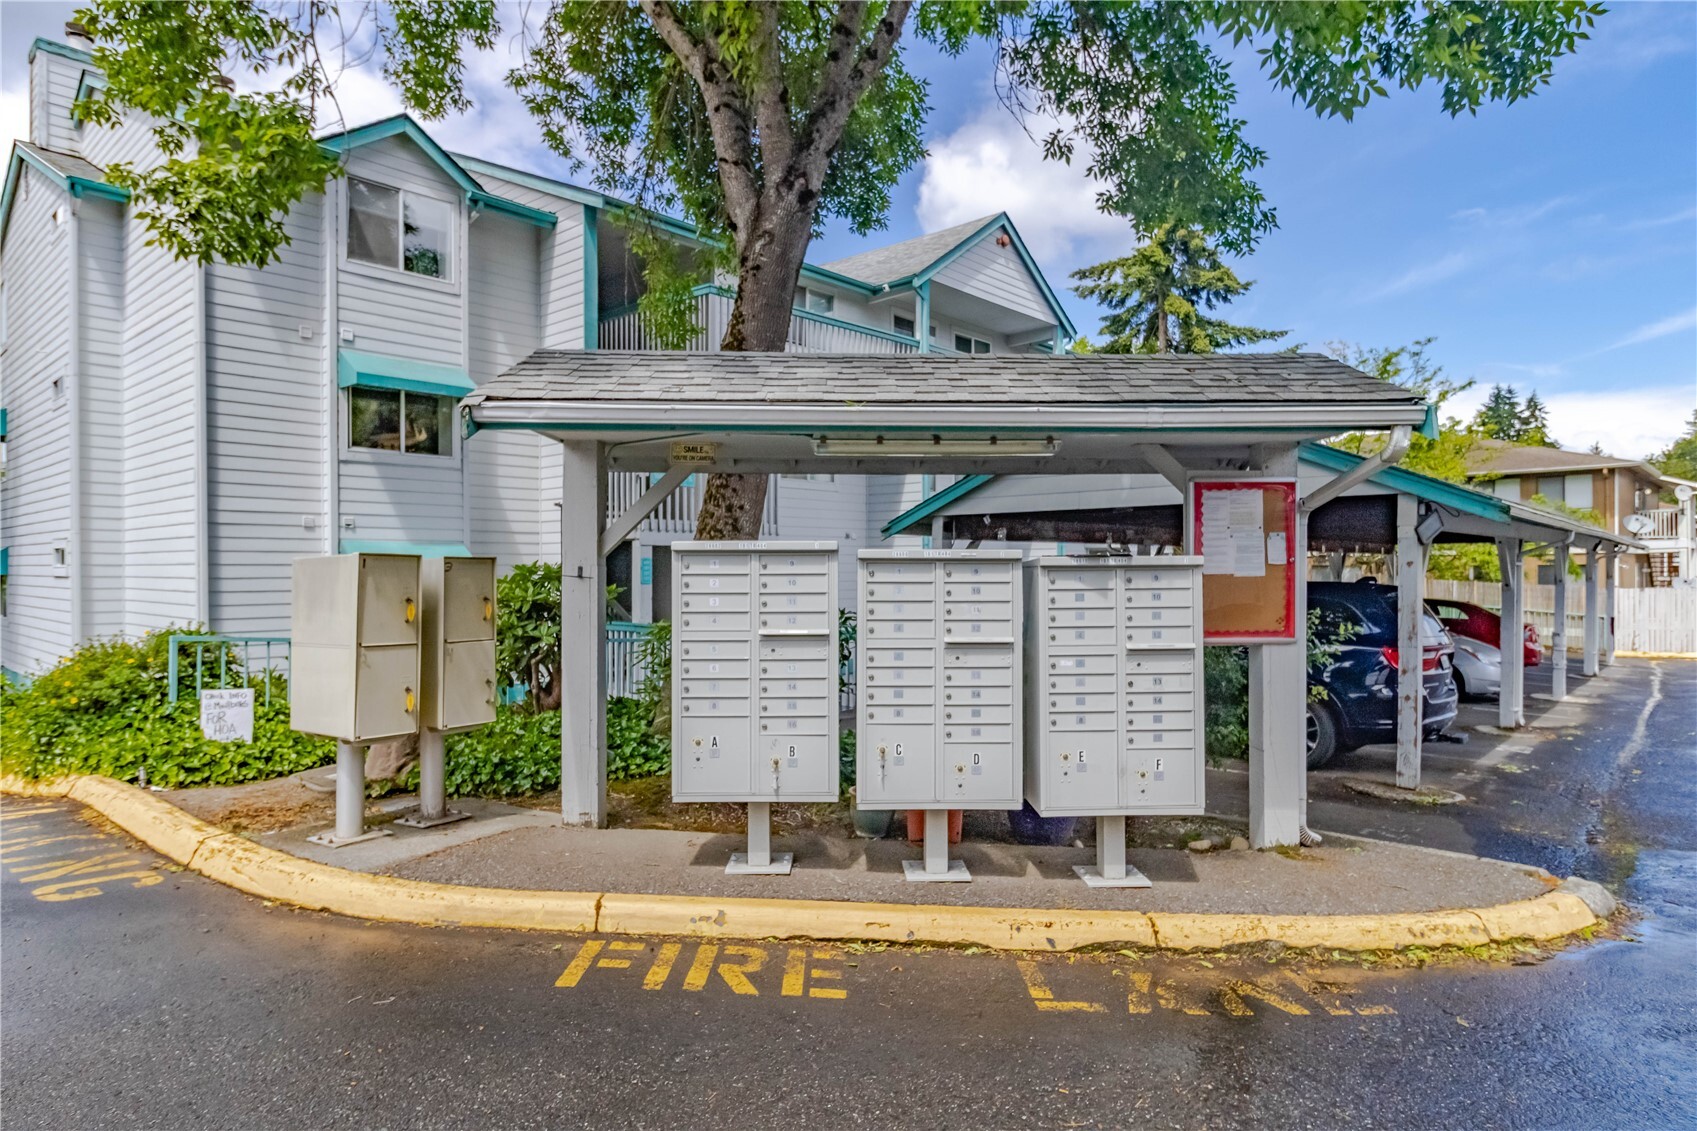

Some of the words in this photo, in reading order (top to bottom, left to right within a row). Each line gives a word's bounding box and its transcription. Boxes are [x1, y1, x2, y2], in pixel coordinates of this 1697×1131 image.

[206, 710, 228, 724] FOR
[214, 723, 237, 736] HOA
[711, 736, 718, 748] A
[789, 746, 795, 757] B
[896, 744, 902, 756] C
[973, 754, 980, 765] D
[1079, 751, 1084, 763] E
[1156, 759, 1162, 770] F
[554, 940, 848, 999] FIRE
